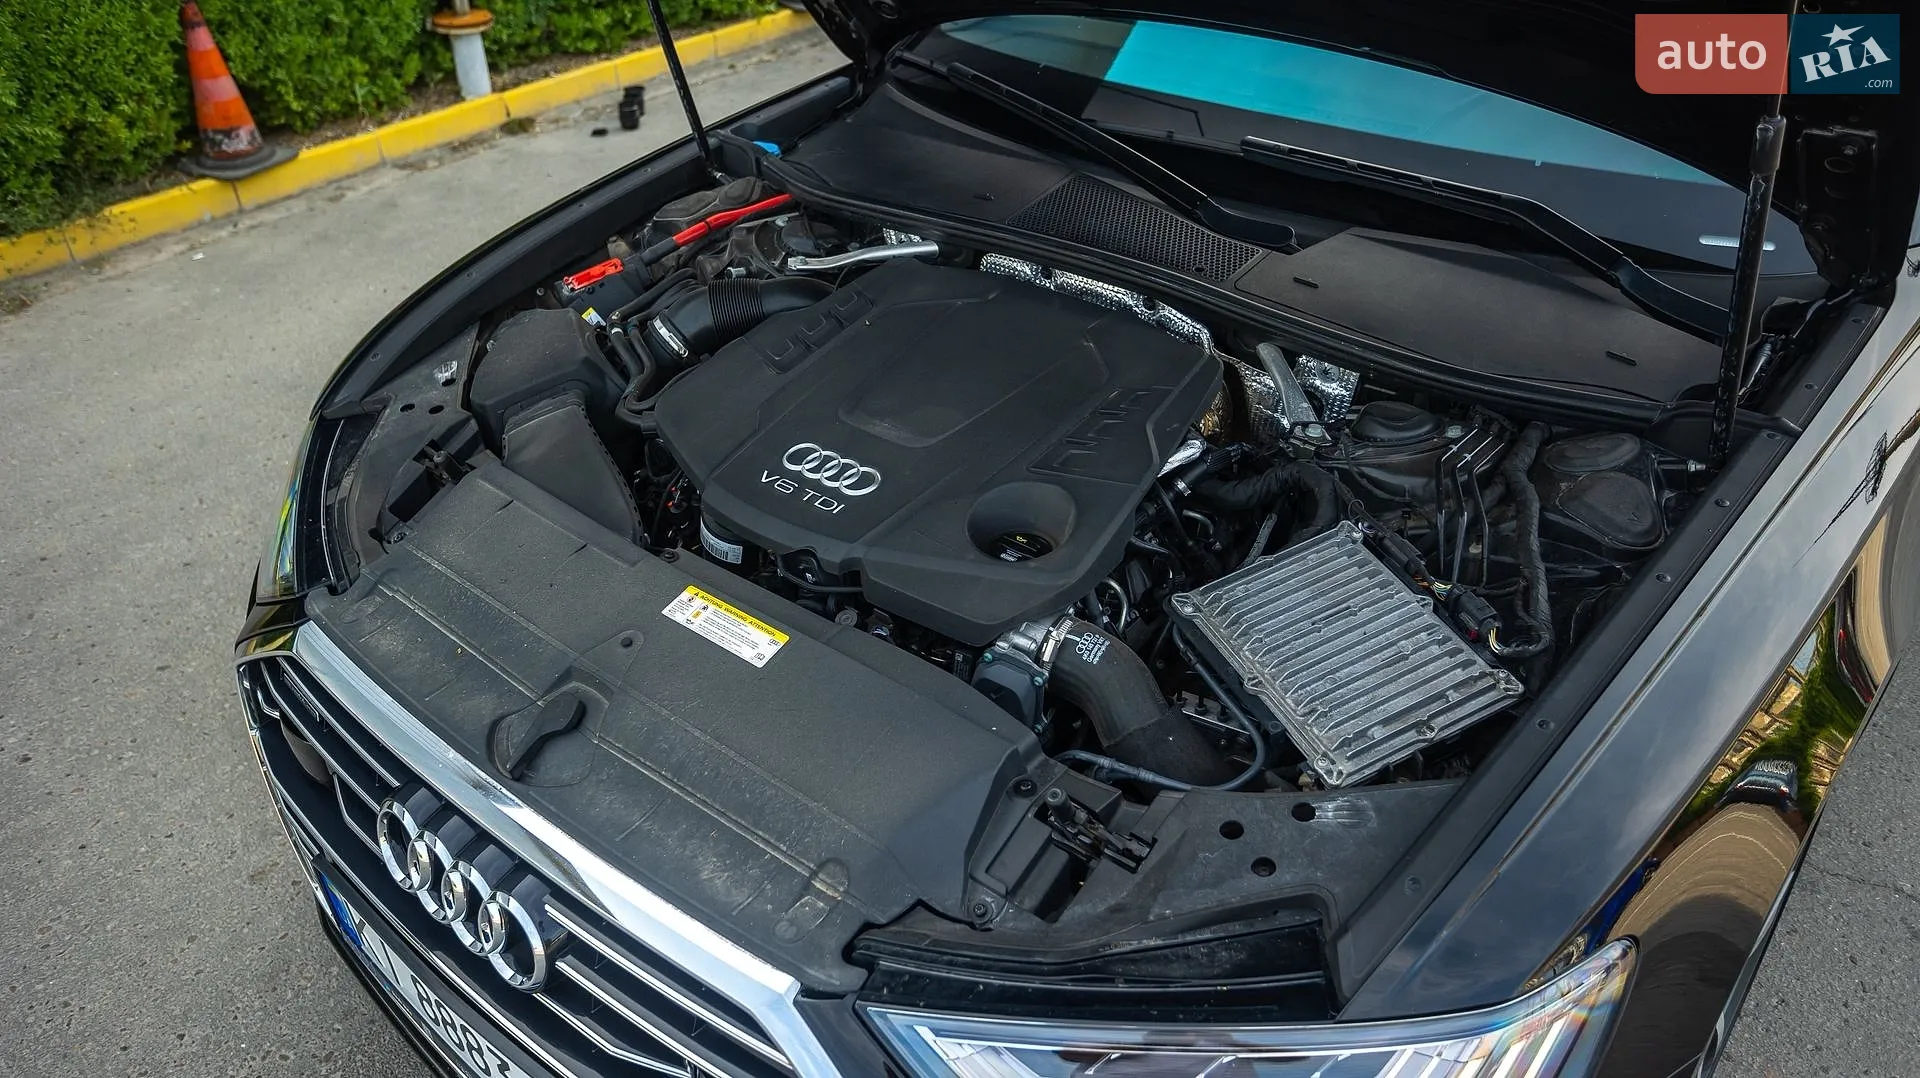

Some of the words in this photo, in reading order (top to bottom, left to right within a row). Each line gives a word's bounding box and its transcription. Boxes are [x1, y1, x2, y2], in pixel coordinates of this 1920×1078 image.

[760, 470, 799, 494] V6
[802, 488, 845, 514] TDI
[700, 595, 724, 610] ACHTUNG
[723, 606, 748, 623] WARNING
[748, 619, 777, 637] ATTENTION
